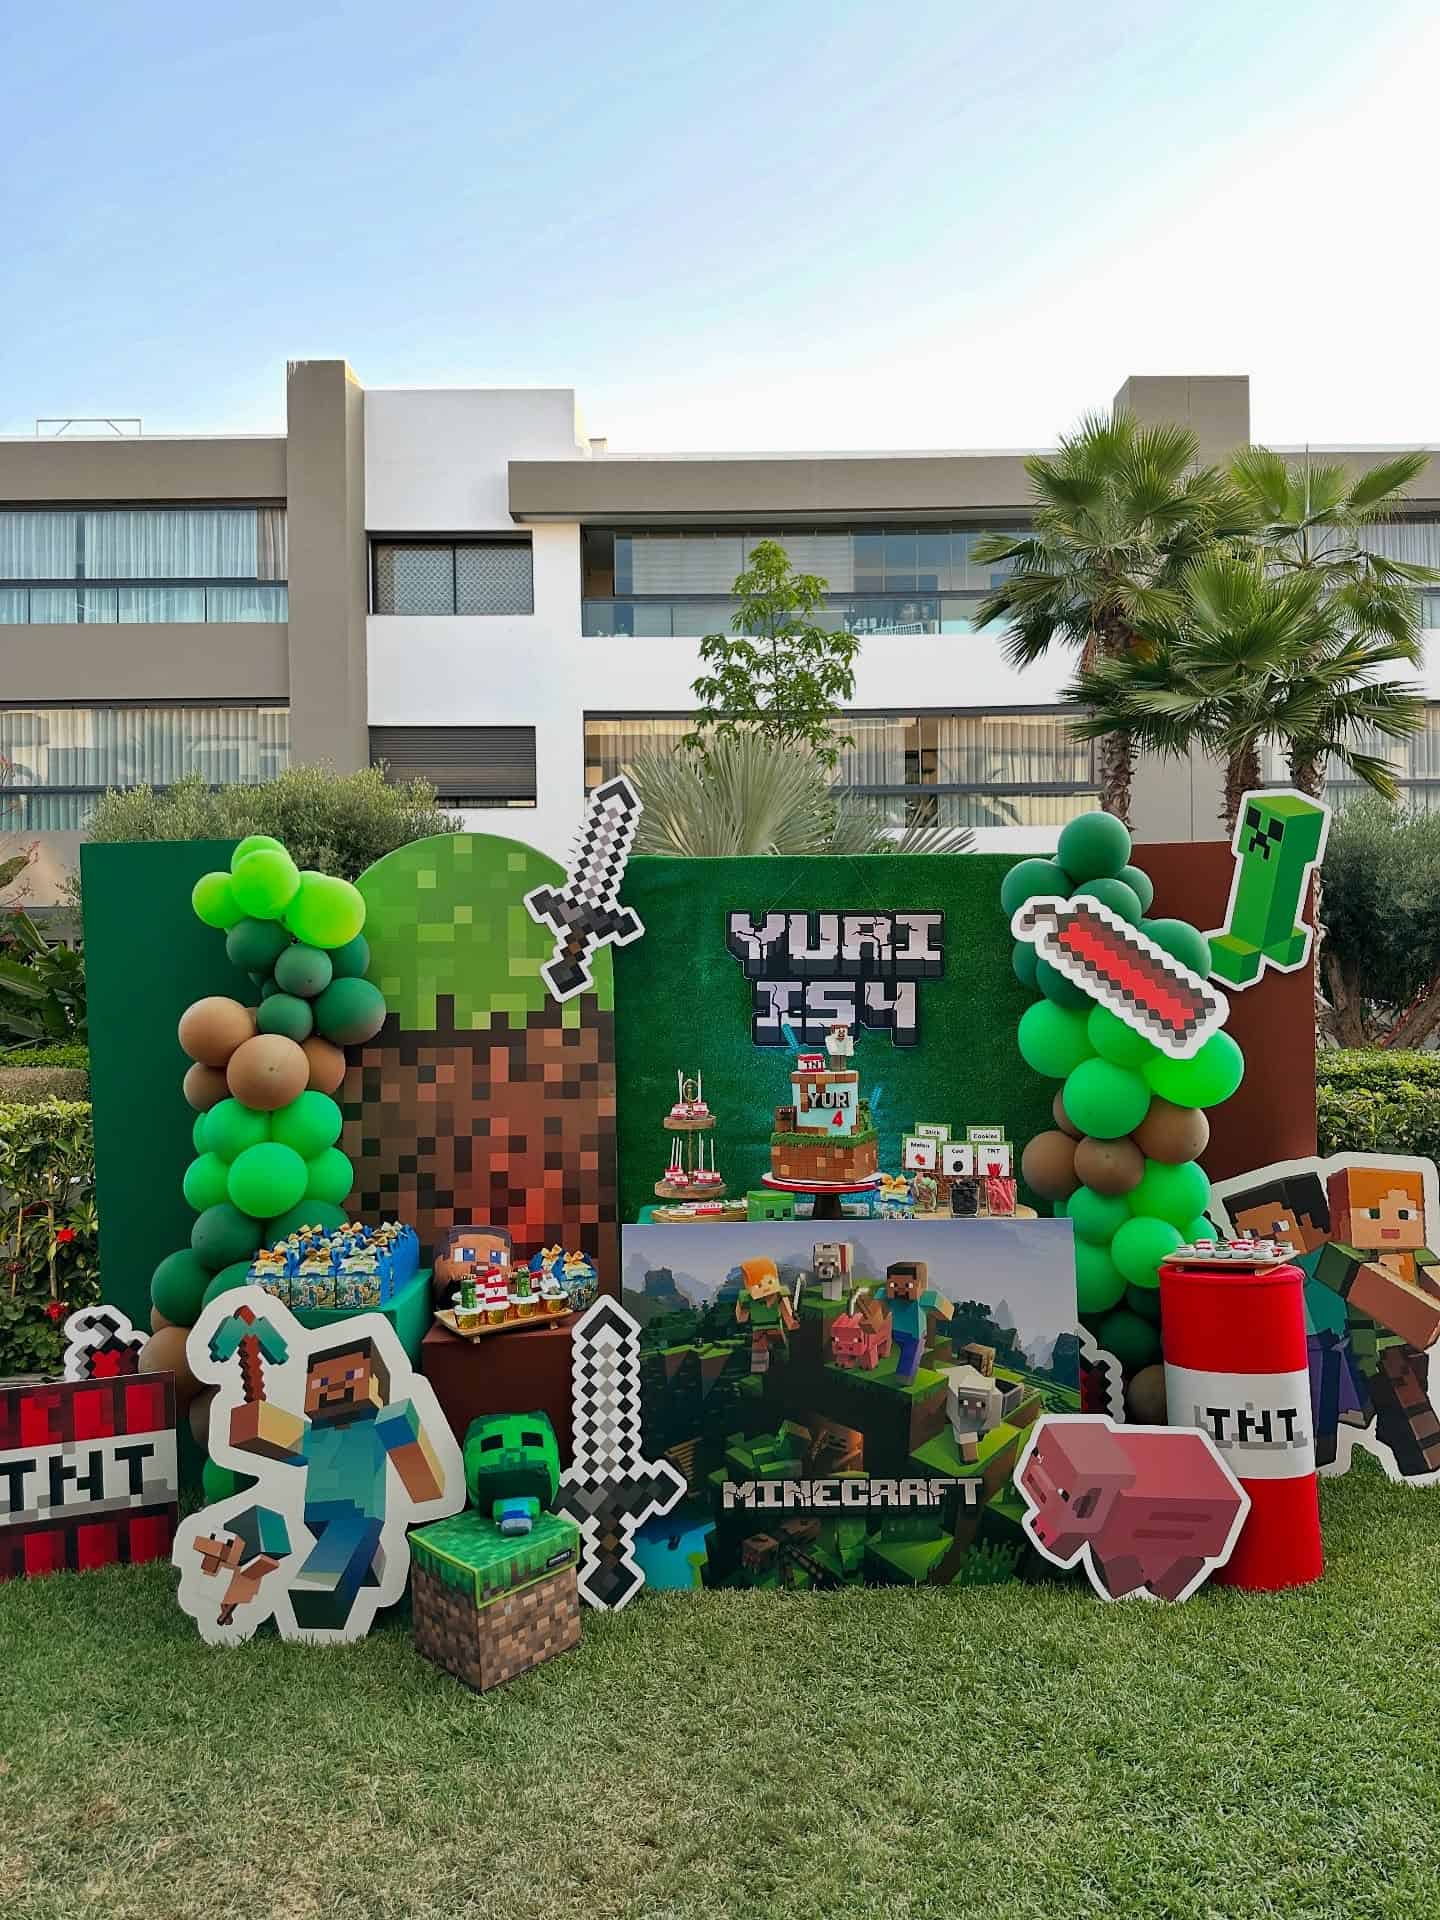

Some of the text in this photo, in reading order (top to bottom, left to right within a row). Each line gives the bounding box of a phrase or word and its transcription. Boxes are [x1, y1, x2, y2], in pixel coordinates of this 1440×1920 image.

[730, 912, 943, 963] YURI
[832, 1109, 844, 1127] 4
[1205, 1406, 1298, 1443] TNT
[0, 1443, 155, 1512] TNT
[722, 1478, 983, 1509] MINECRAFT
